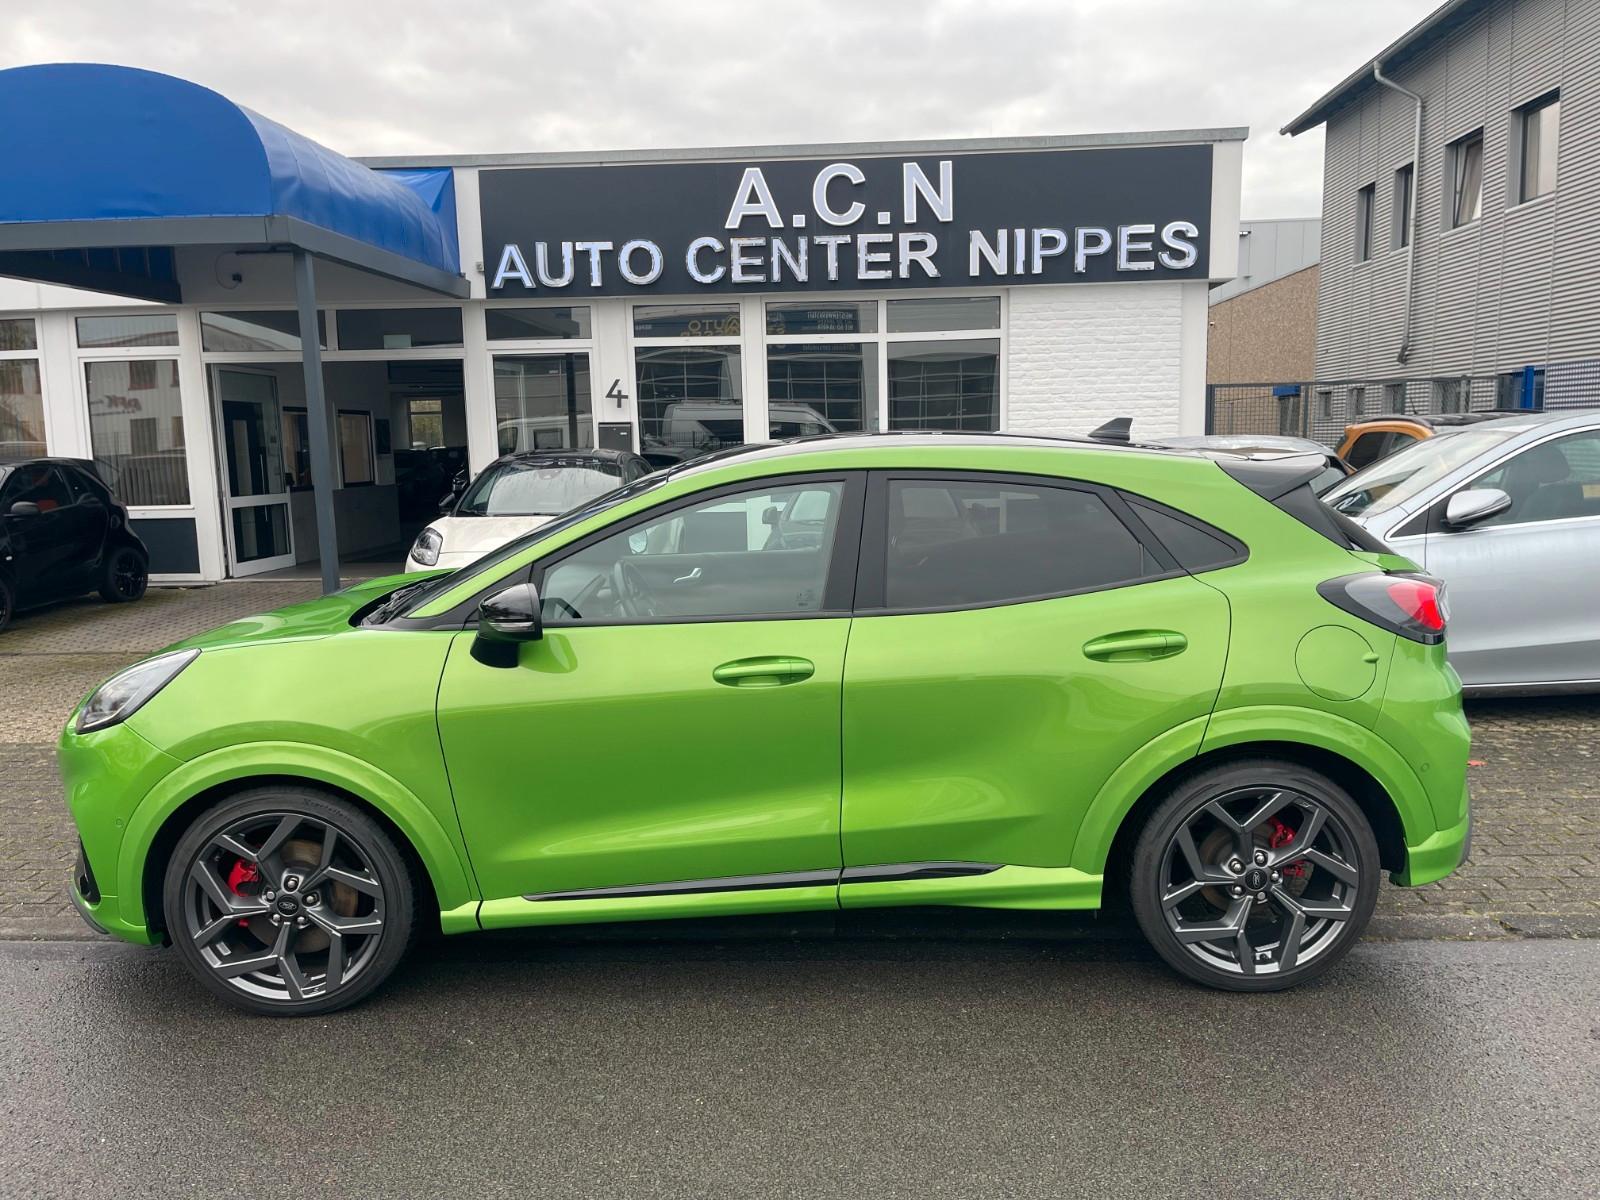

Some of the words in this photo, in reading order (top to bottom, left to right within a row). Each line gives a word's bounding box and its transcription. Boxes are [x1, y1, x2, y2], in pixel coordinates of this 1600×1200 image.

[725, 160, 953, 229] A.C.N
[491, 239, 664, 289] AUTO
[685, 232, 941, 284] CENTER
[969, 221, 1199, 277] NIPPES
[605, 379, 629, 408] 4
